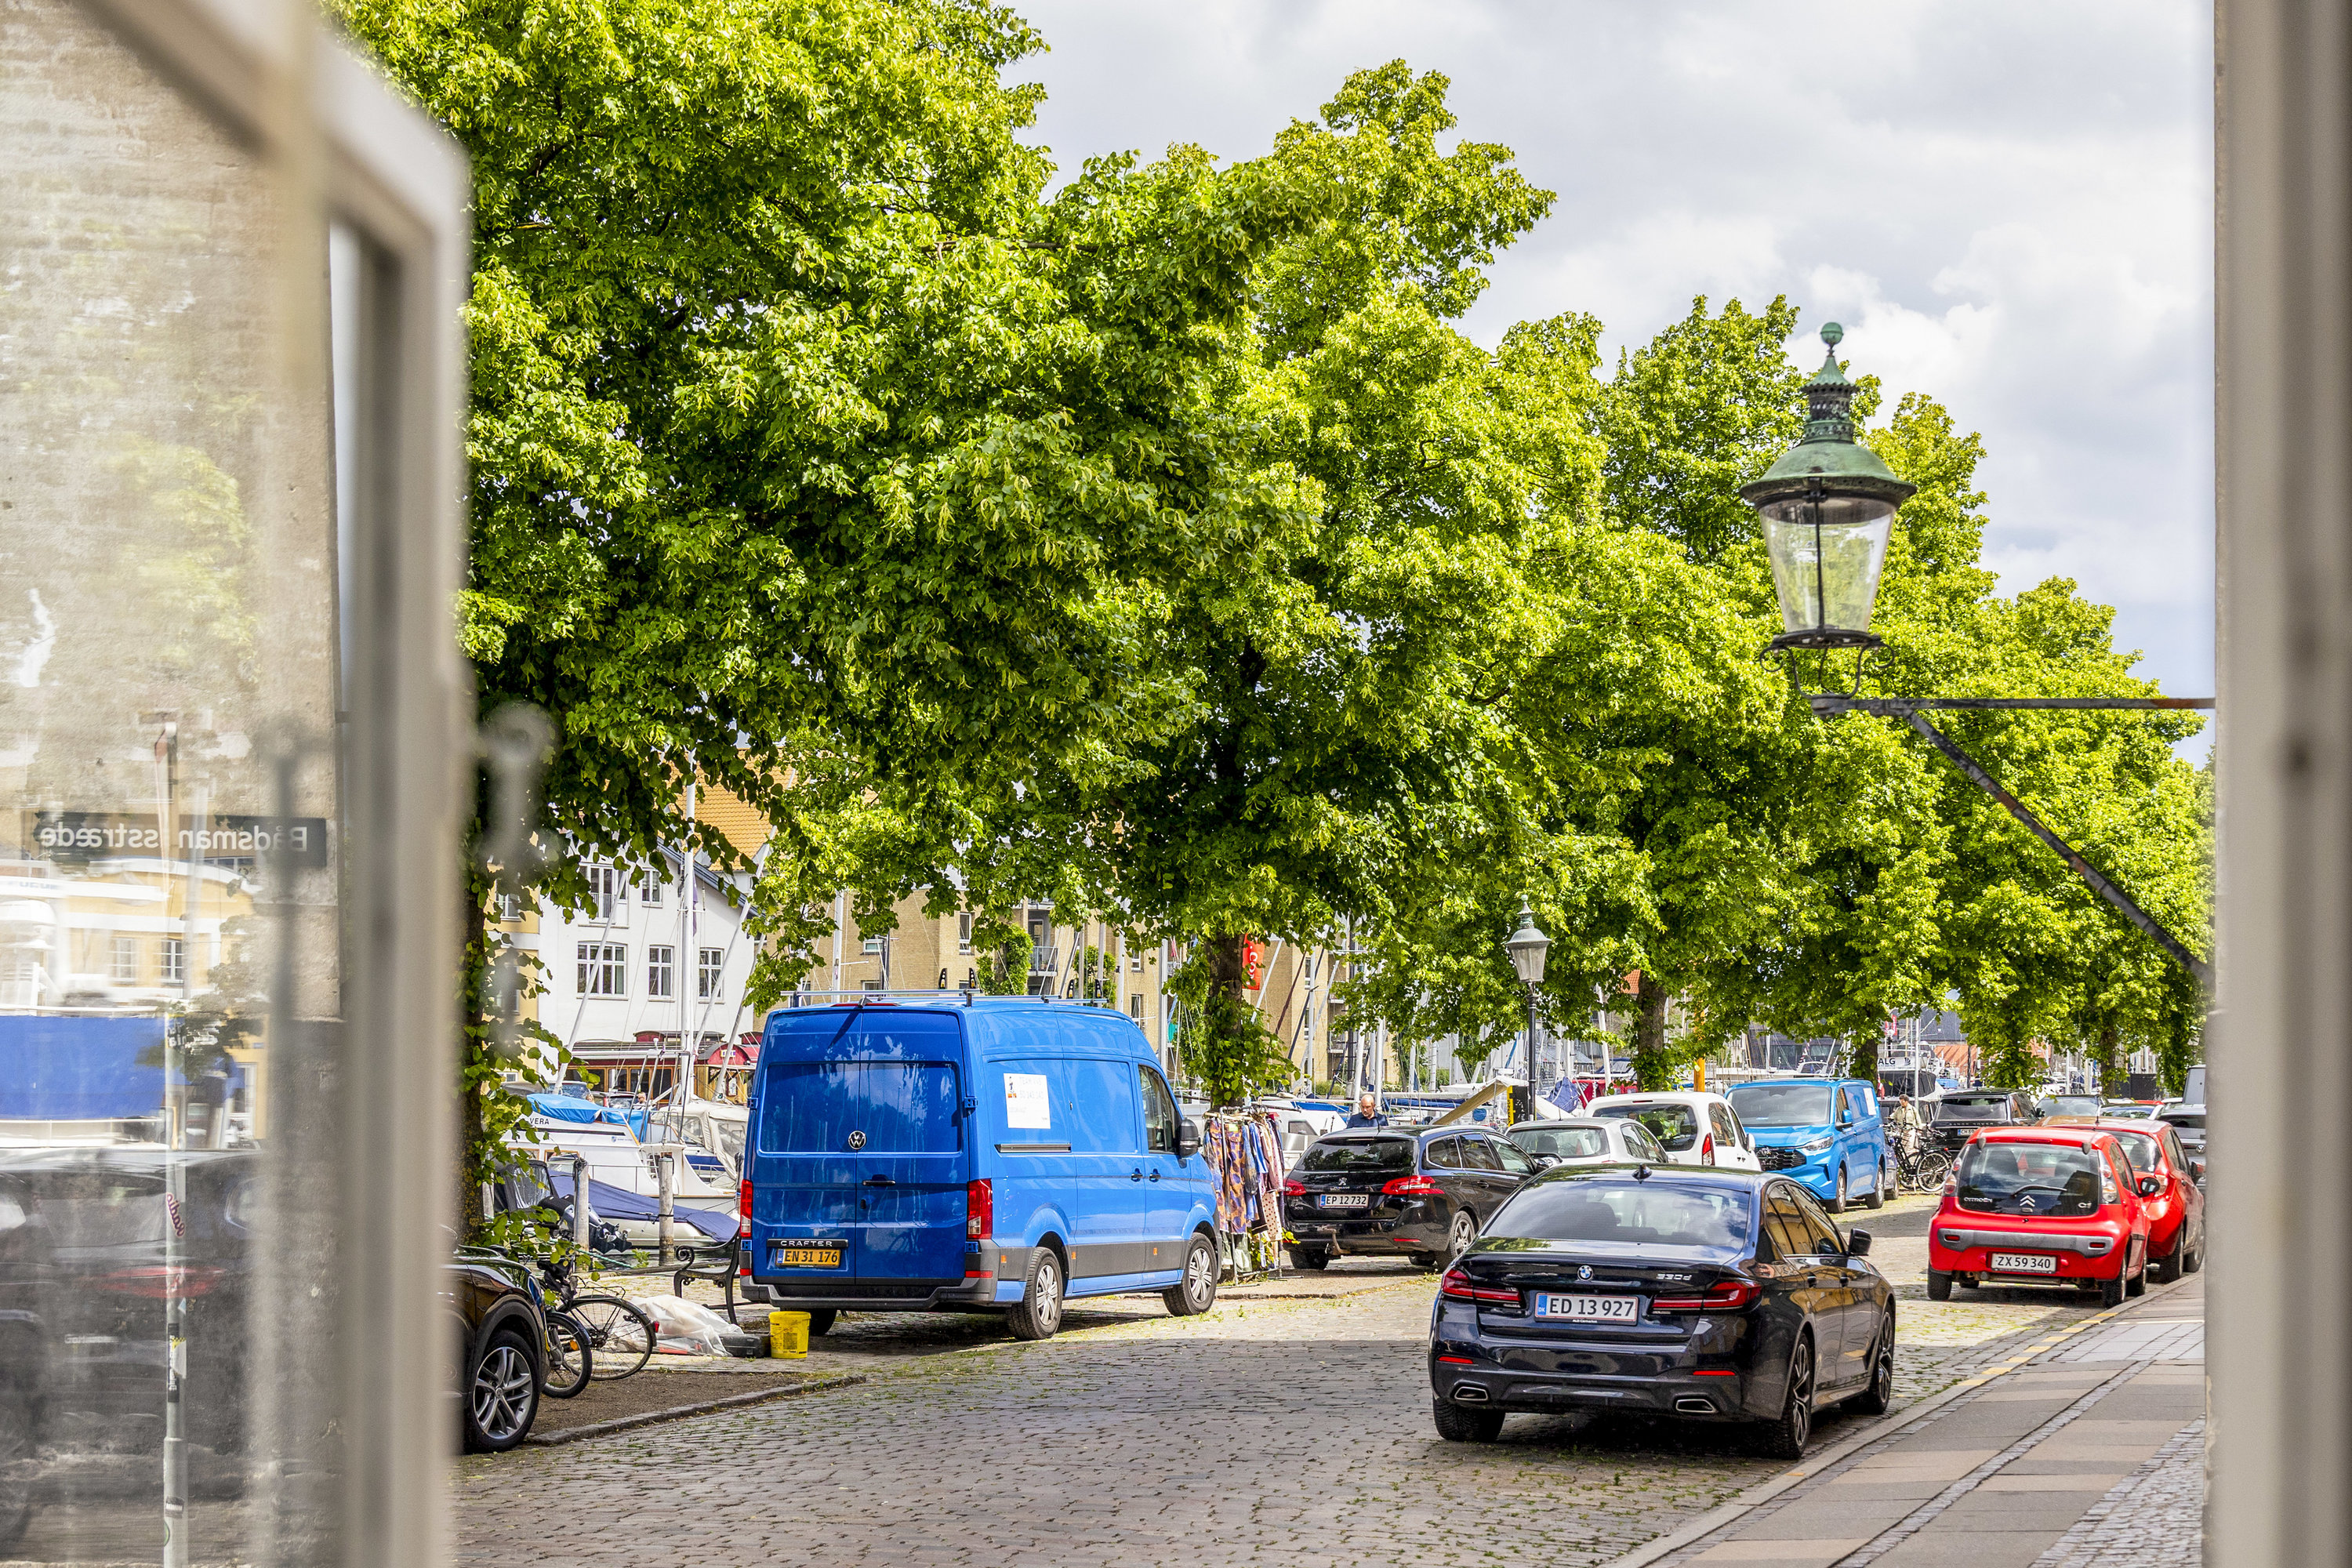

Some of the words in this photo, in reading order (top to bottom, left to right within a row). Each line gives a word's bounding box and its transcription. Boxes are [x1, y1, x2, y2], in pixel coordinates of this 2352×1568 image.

[1326, 1196, 1338, 1204] EP
[1340, 1196, 1349, 1204] 12
[1351, 1196, 1367, 1204] 732
[785, 1250, 800, 1261] EN
[801, 1250, 813, 1262] 31
[818, 1251, 838, 1262] 176
[1998, 1256, 2013, 1266] ZX
[2015, 1257, 2028, 1267] 59
[2031, 1258, 2051, 1269] 340
[1549, 1298, 1572, 1314] ED
[1577, 1299, 1597, 1316] 13
[1602, 1300, 1634, 1316] 927
